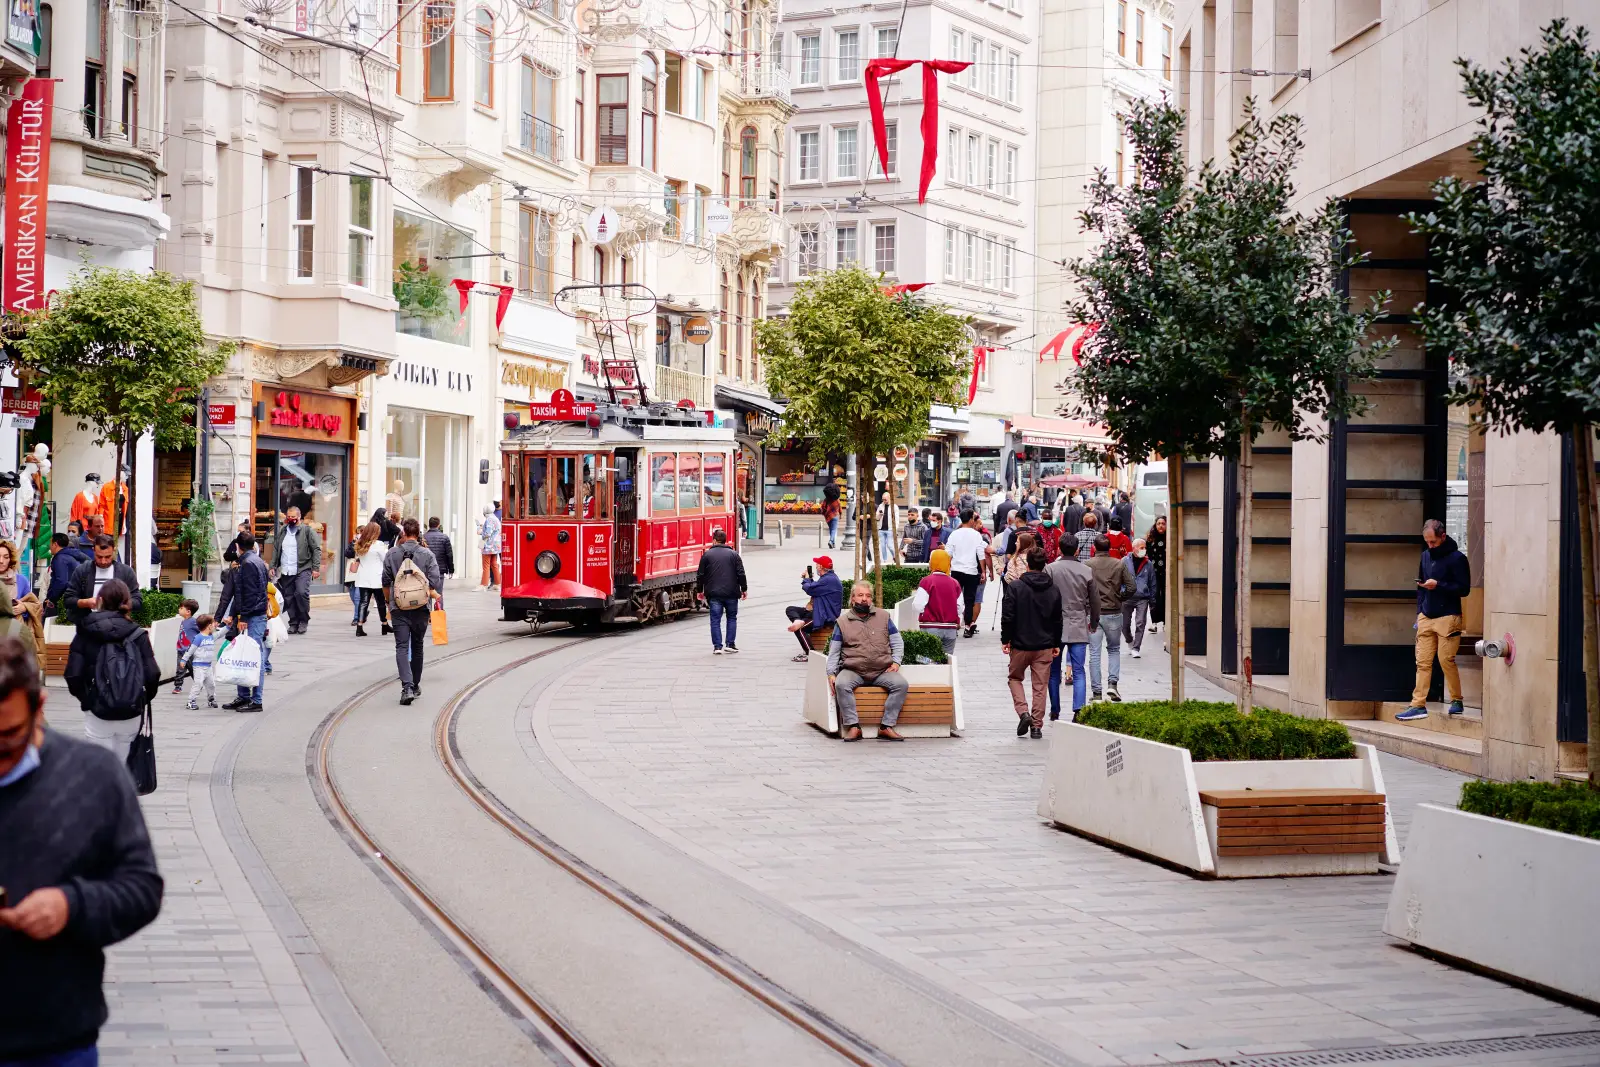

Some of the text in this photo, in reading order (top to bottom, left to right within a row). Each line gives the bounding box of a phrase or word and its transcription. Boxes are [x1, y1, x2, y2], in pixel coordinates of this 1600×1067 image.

[16, 97, 43, 183] KÜLTÜR
[559, 390, 565, 402] 2
[3, 398, 40, 411] BERBER
[532, 404, 557, 417] TAKSİM
[594, 534, 605, 544] 223
